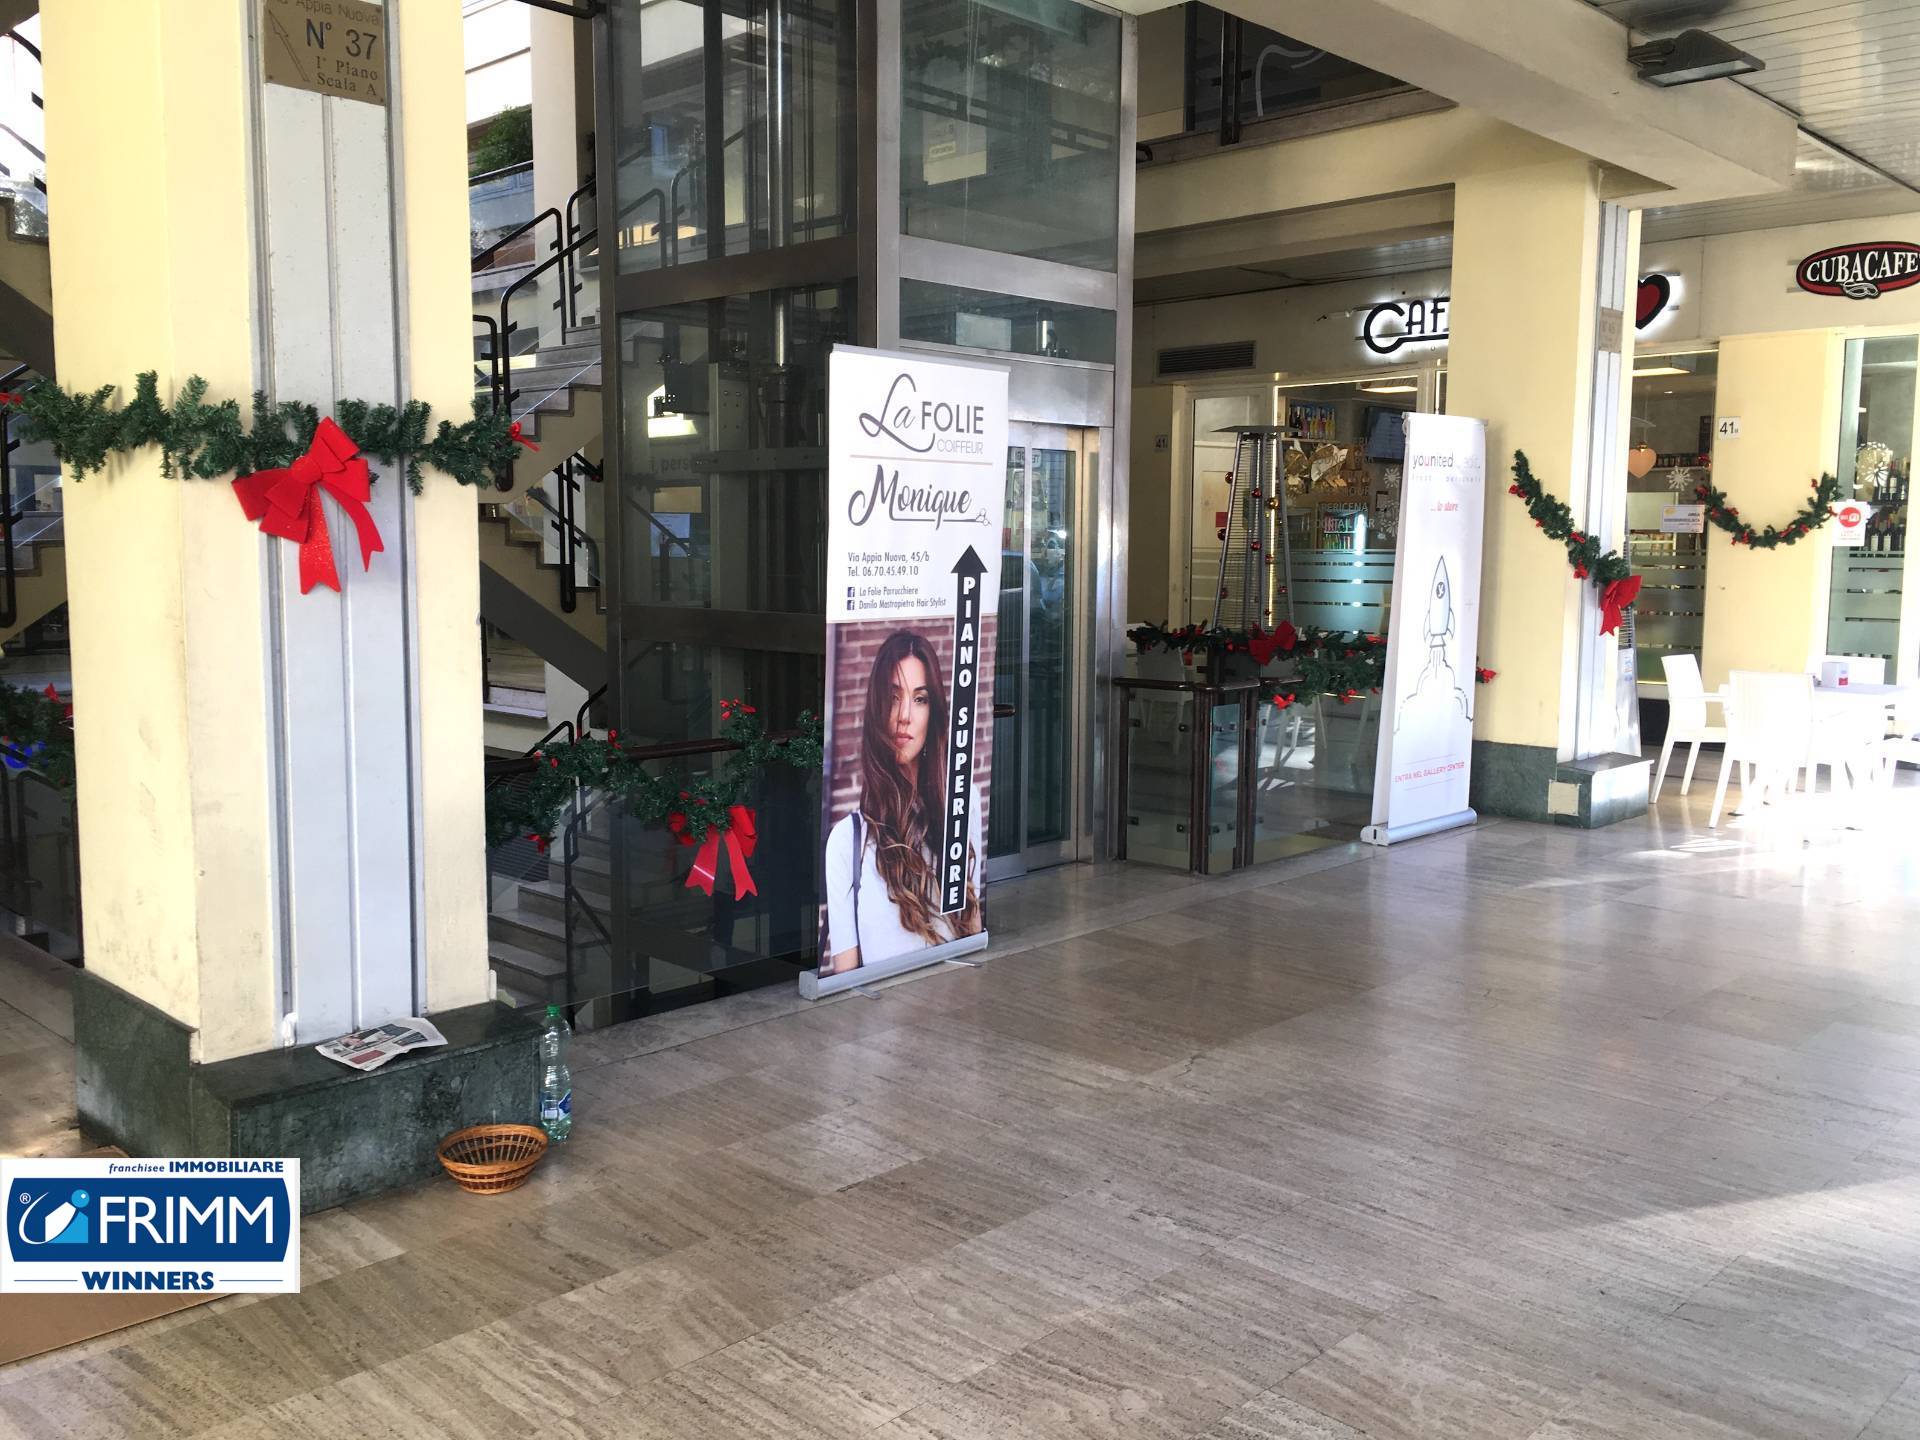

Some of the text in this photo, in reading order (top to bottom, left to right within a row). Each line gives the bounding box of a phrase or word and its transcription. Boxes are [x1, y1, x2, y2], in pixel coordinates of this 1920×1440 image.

[338, 4, 379, 26] Nuova
[345, 29, 377, 60] 37
[336, 60, 378, 81] Piano
[317, 72, 377, 96] Scala A
[1806, 251, 1919, 283] CUBACAFE
[1364, 297, 1450, 354] CAF
[859, 373, 984, 453] La FOLIE
[936, 439, 984, 455] COIFFEUR
[1412, 451, 1454, 470] younited
[848, 464, 973, 531] Monique
[1318, 502, 1368, 512] PERICENA
[848, 551, 930, 564] Via Appia Nuova, 45/b
[848, 566, 919, 577] Tel. 06.70.45.49.10
[868, 587, 882, 596] Folie
[883, 586, 919, 596] Parrucchiere
[859, 599, 878, 609] Danilo
[879, 599, 915, 610] Mastropietro
[916, 598, 929, 607] Hair
[929, 597, 947, 608] Stylist
[959, 576, 976, 688] PIANO
[1423, 766, 1446, 777] GALLERY
[949, 706, 969, 905] SUPERIORE
